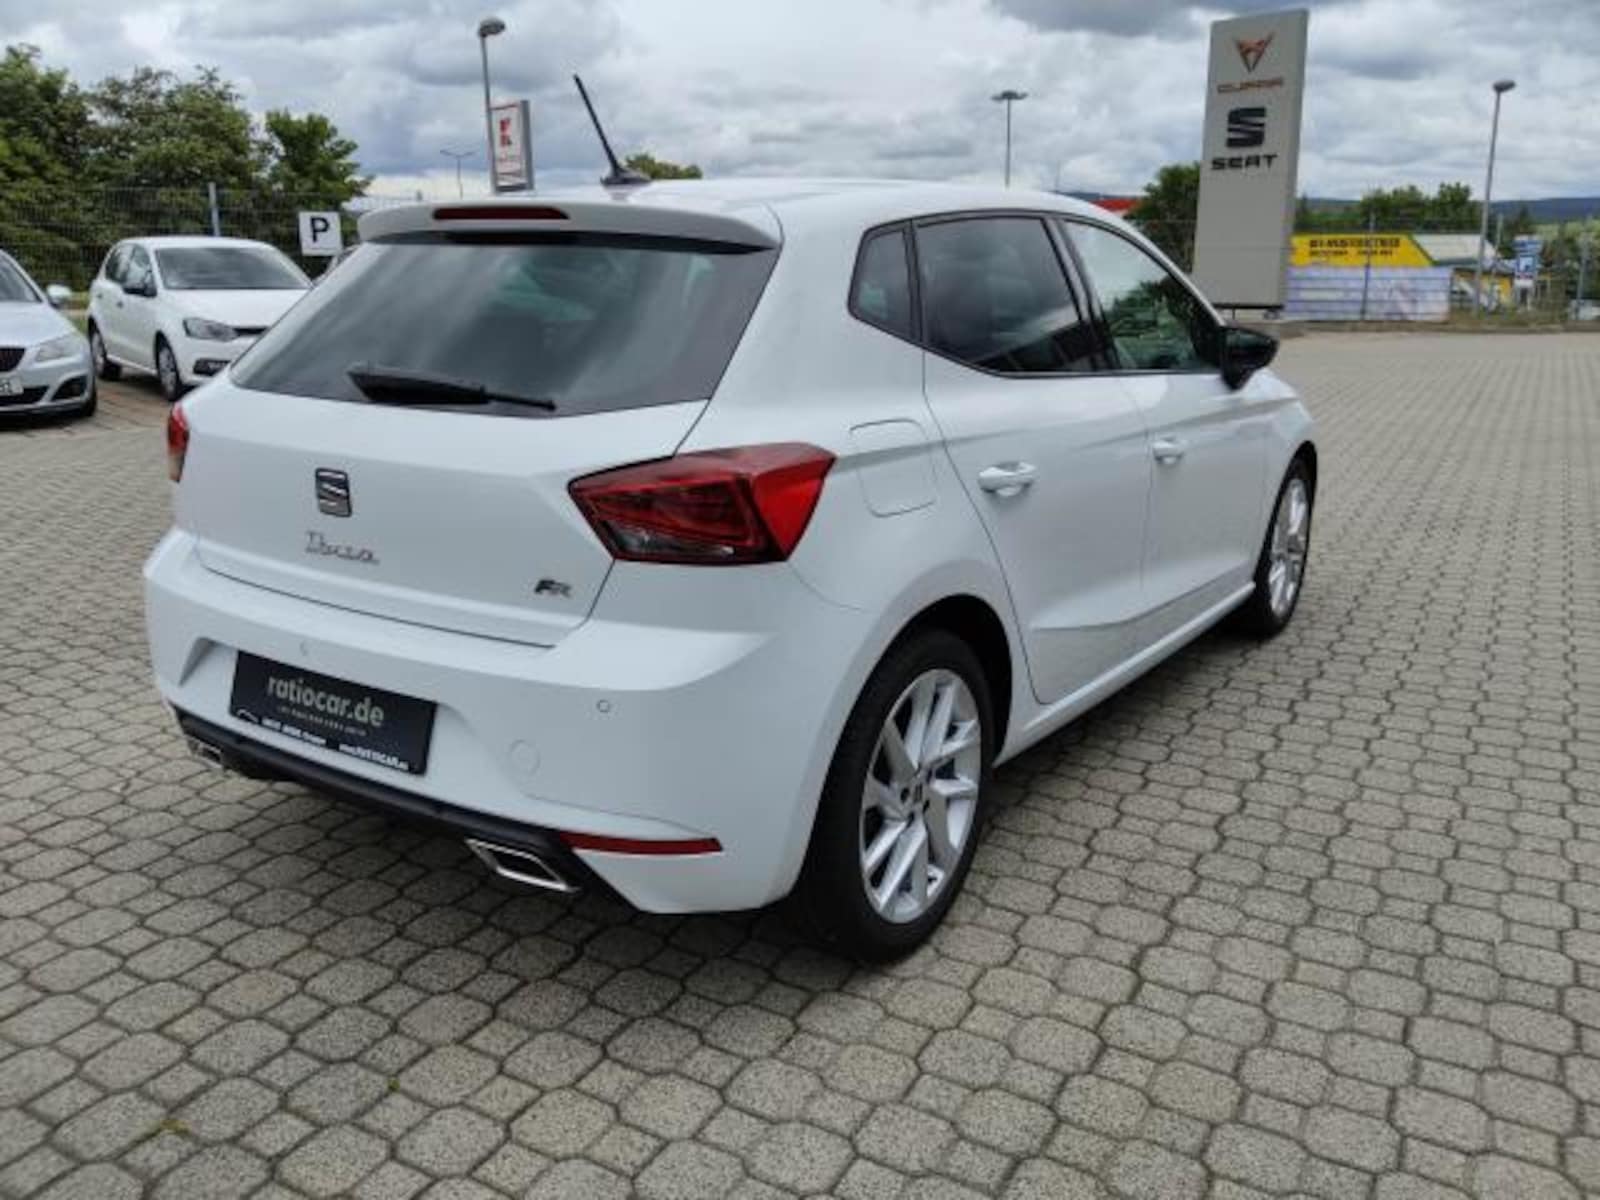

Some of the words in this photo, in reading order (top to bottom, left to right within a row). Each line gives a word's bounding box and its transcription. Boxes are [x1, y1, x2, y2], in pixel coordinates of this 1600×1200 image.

[1211, 154, 1278, 170] SEAT
[310, 217, 330, 243] P
[267, 675, 384, 727] ratiocar.de
